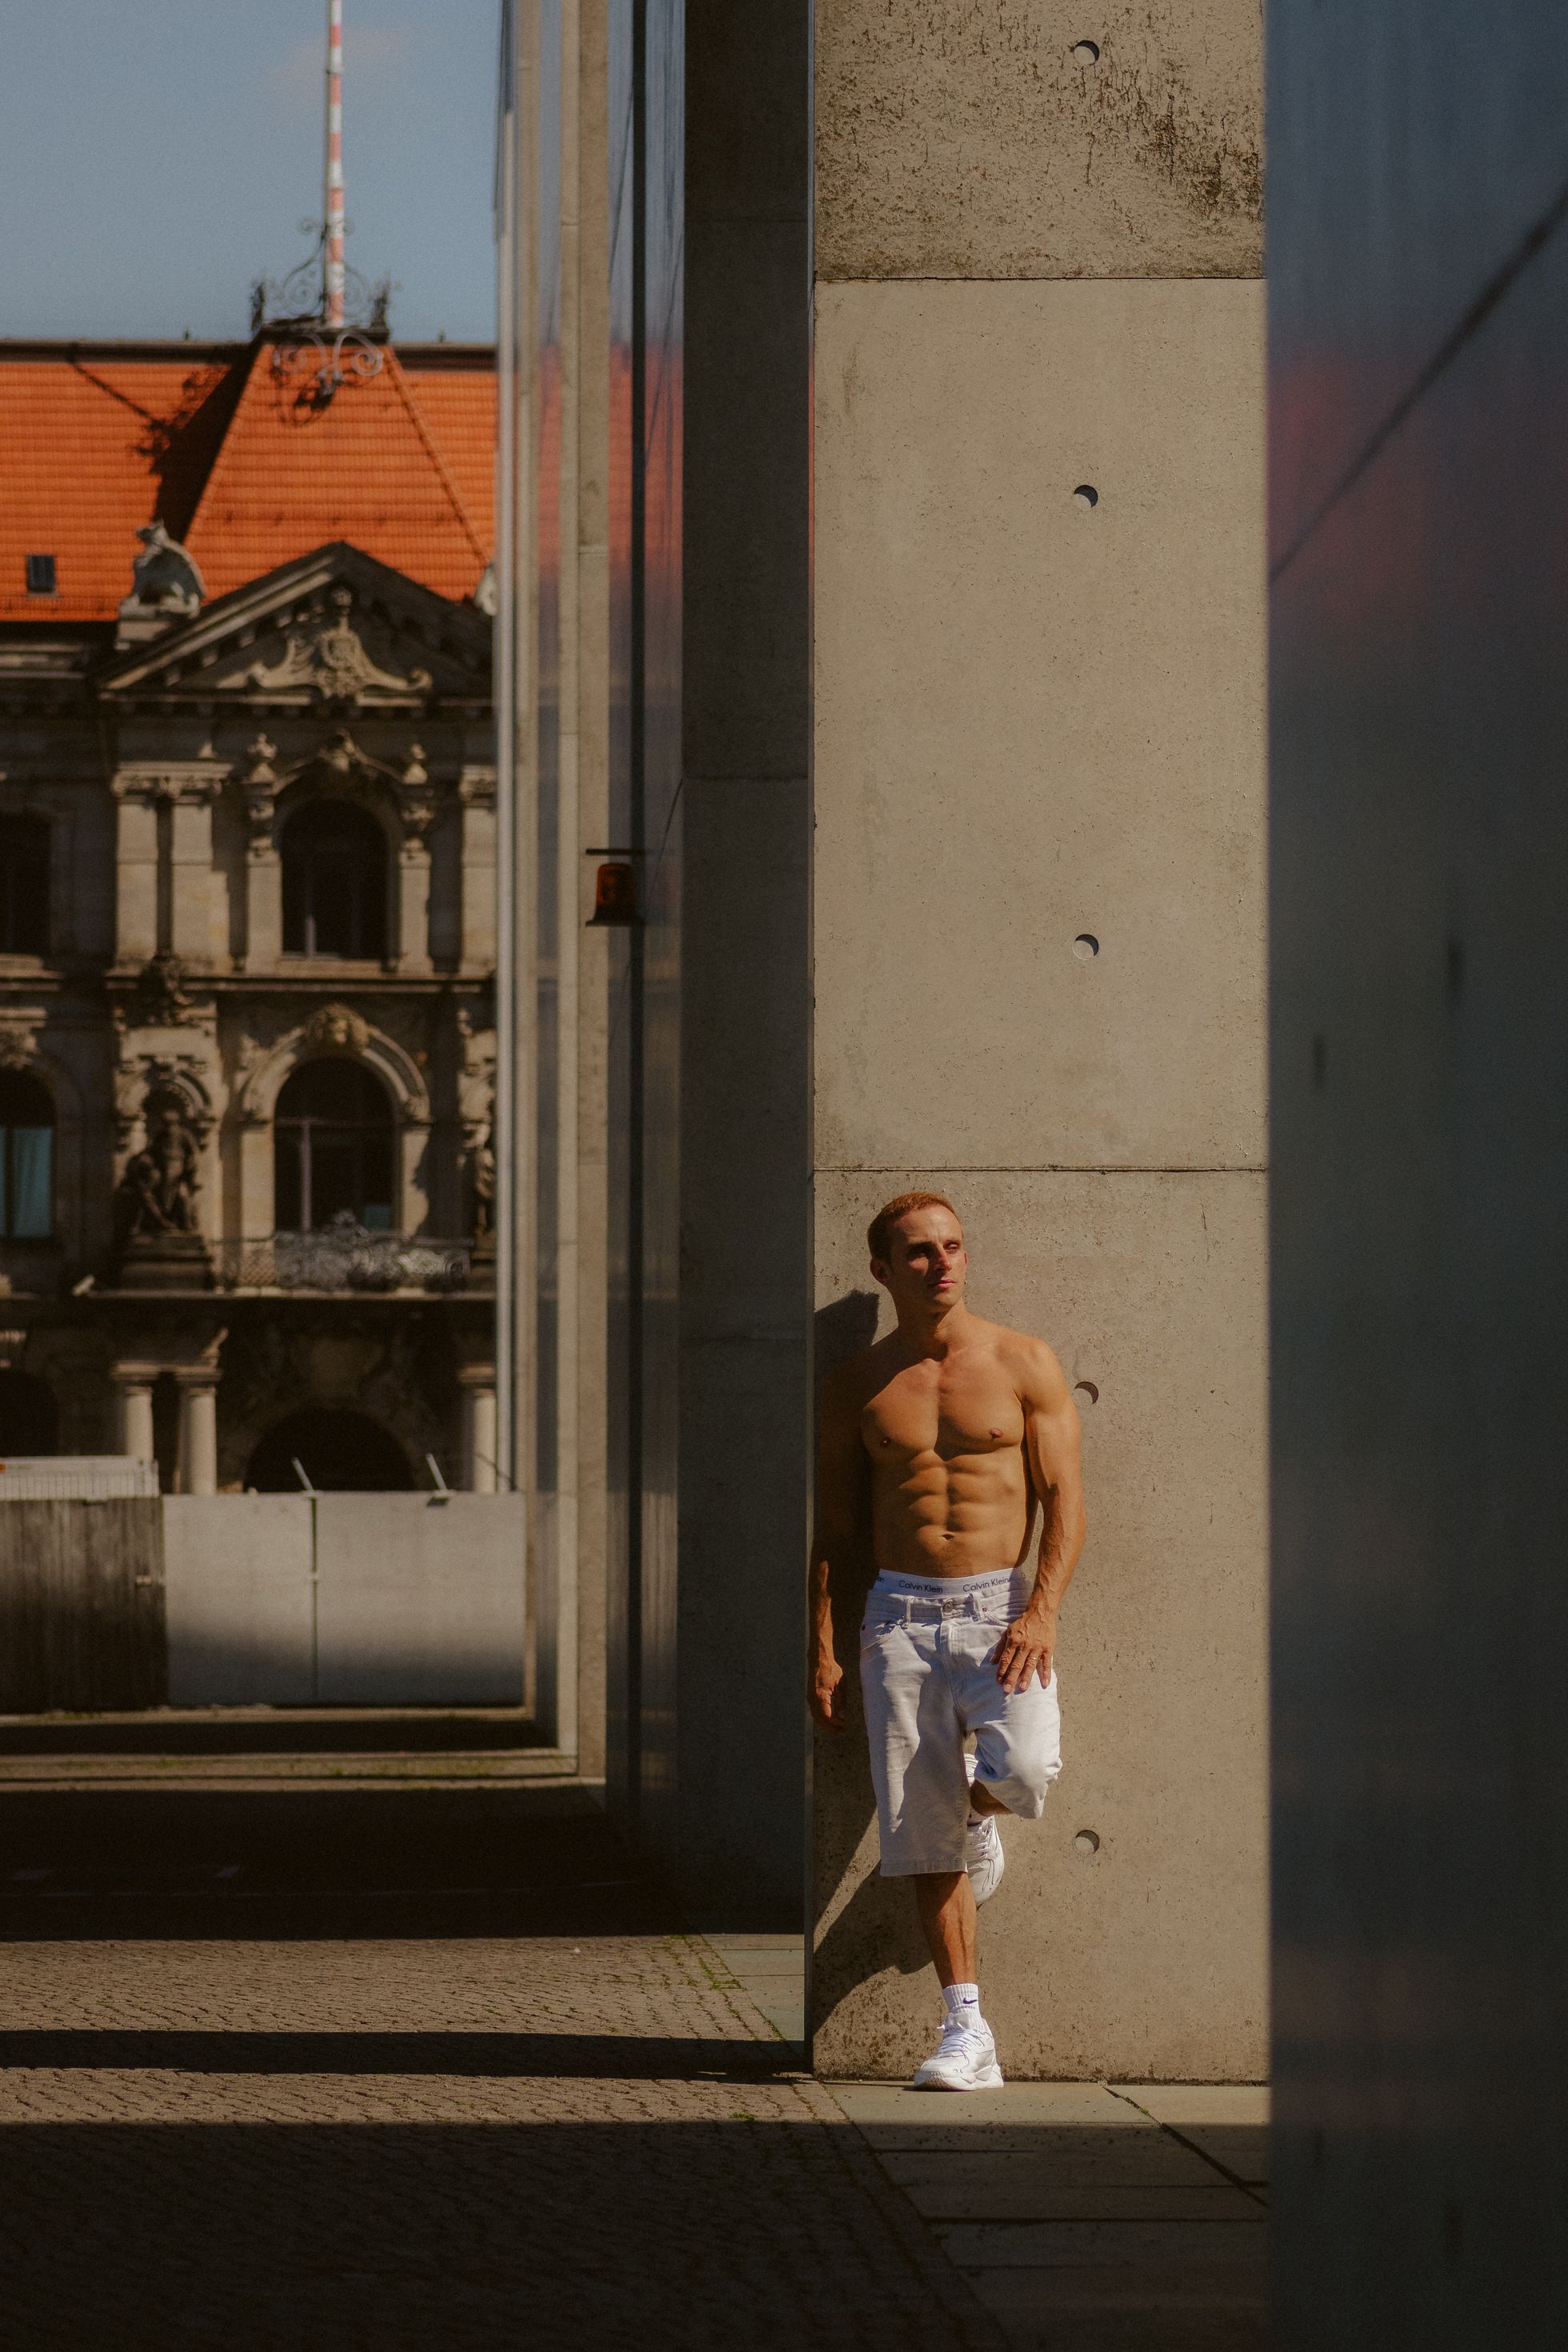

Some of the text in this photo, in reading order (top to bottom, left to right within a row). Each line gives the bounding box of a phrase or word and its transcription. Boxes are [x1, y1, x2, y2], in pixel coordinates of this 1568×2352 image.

[898, 1580, 943, 1593] Calvin Klein
[962, 1578, 1010, 1592] Calvin Klein
